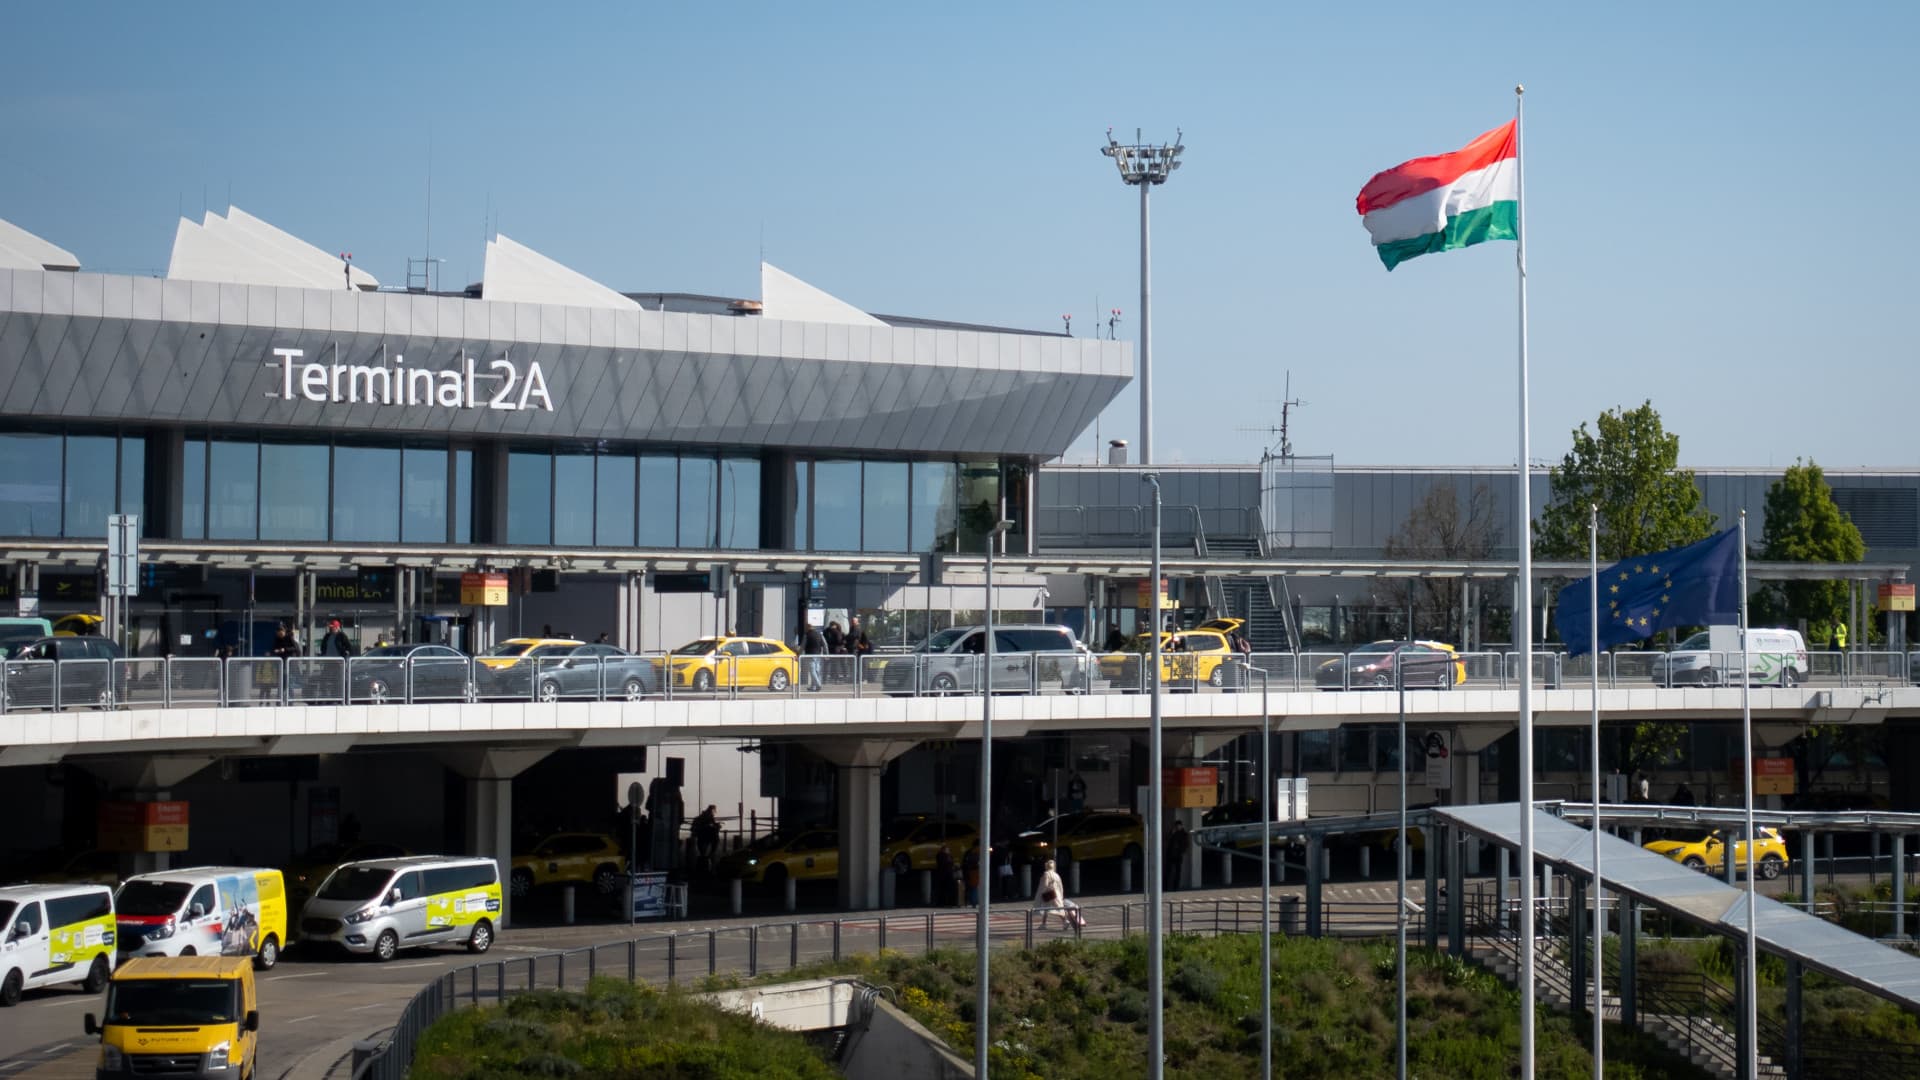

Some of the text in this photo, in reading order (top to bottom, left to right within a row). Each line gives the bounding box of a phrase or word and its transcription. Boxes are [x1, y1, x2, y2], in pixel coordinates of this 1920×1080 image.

[273, 347, 554, 412] Terminal 2A
[304, 582, 359, 599] eminal
